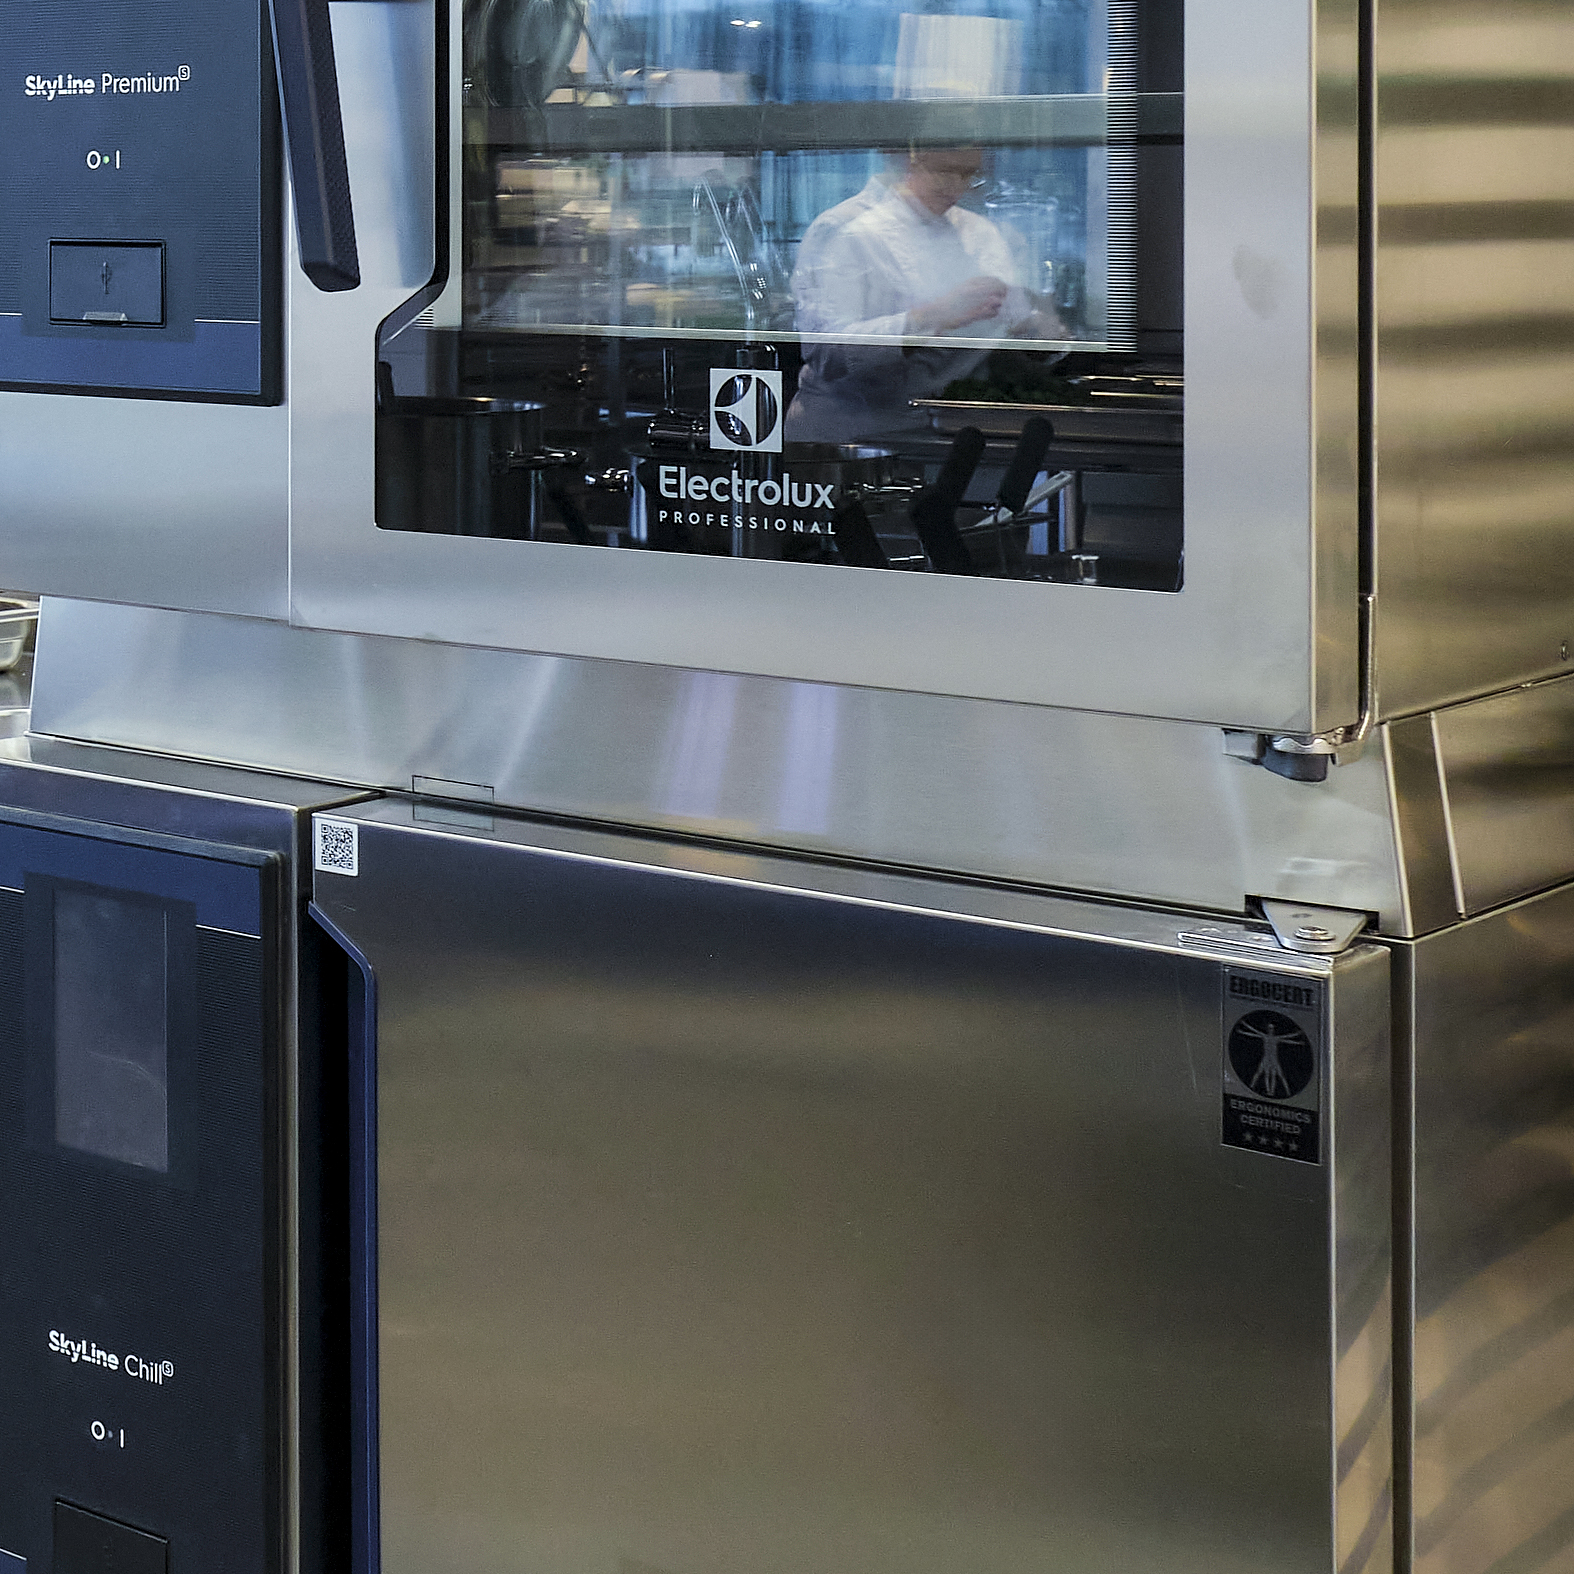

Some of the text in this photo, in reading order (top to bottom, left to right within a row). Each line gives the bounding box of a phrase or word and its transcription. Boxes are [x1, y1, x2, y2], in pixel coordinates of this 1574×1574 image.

[24, 73, 95, 101] SkyLine
[658, 464, 835, 509] Electrolux
[658, 509, 836, 535] PROFESSIONAL
[1229, 974, 1314, 1006] ERGOCERT
[1229, 1098, 1311, 1124] ERGONOMICS
[1239, 1114, 1301, 1134] CERTIFIED
[48, 1329, 120, 1371] SkyLine
